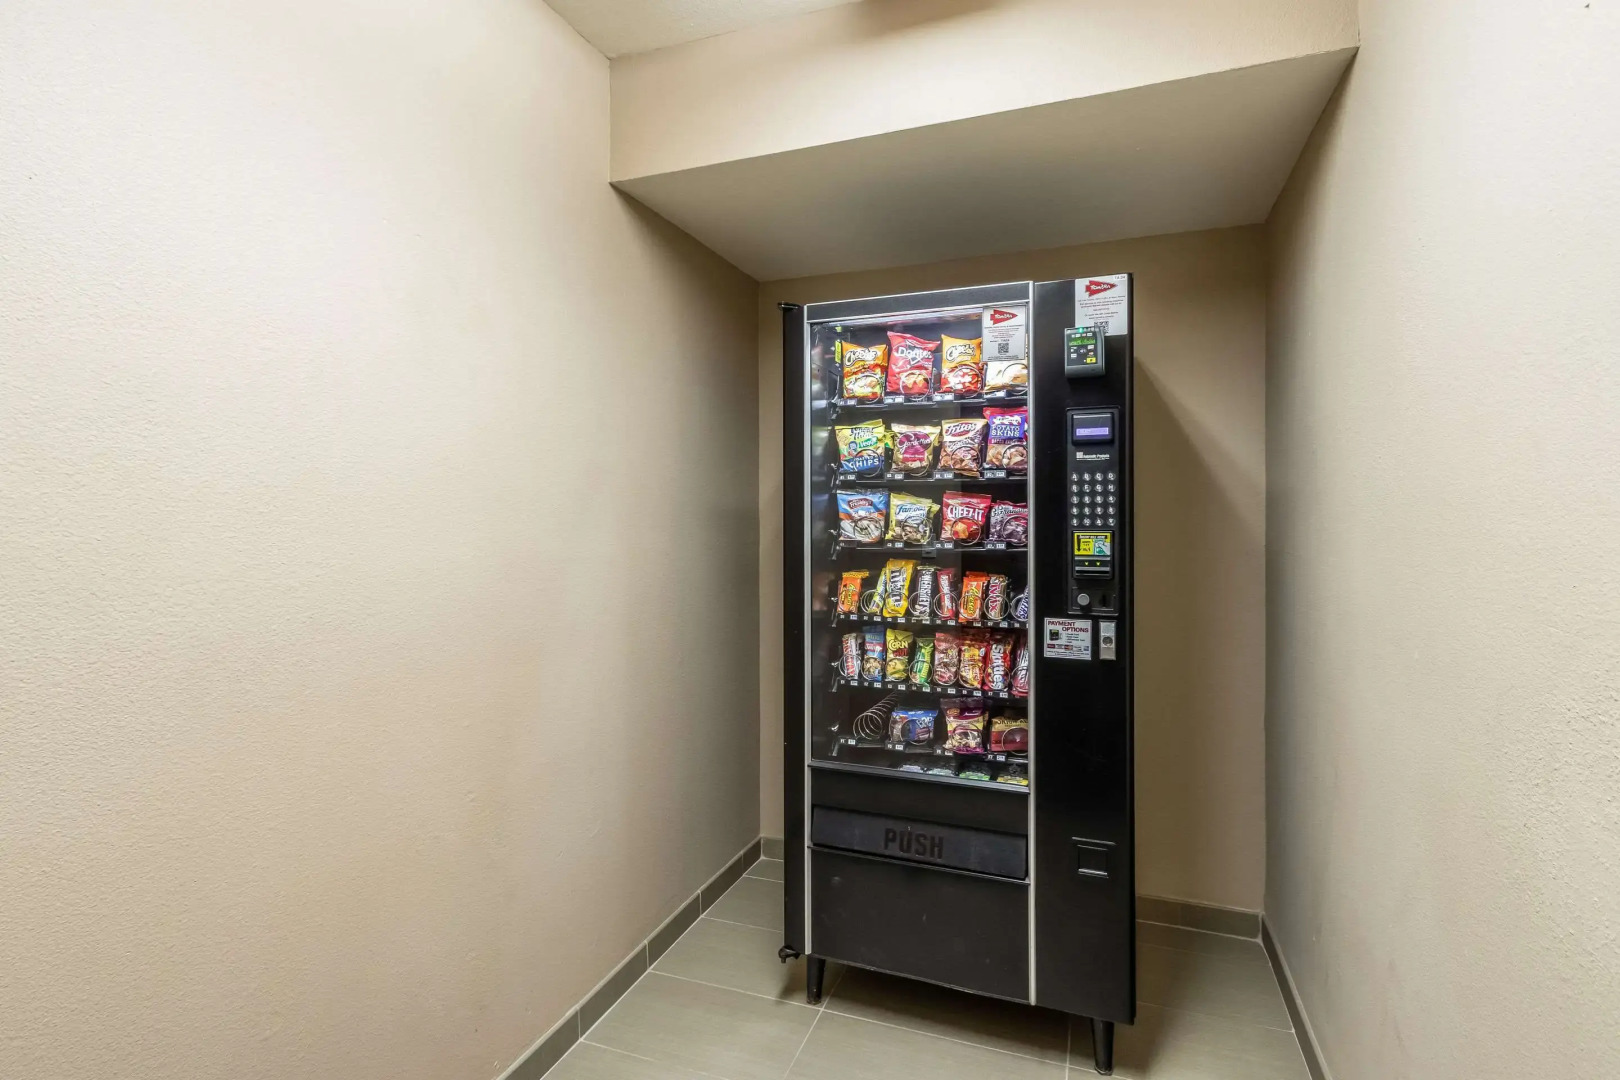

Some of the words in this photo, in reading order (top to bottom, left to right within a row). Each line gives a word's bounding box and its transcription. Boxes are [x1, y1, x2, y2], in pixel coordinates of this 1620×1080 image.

[945, 423, 977, 434] Fritos
[850, 458, 879, 469] CHIPS
[947, 505, 985, 522] CHEEZ-IT
[888, 640, 908, 651] CORN
[992, 644, 1004, 691] Skittles
[884, 827, 944, 861] PUSH
